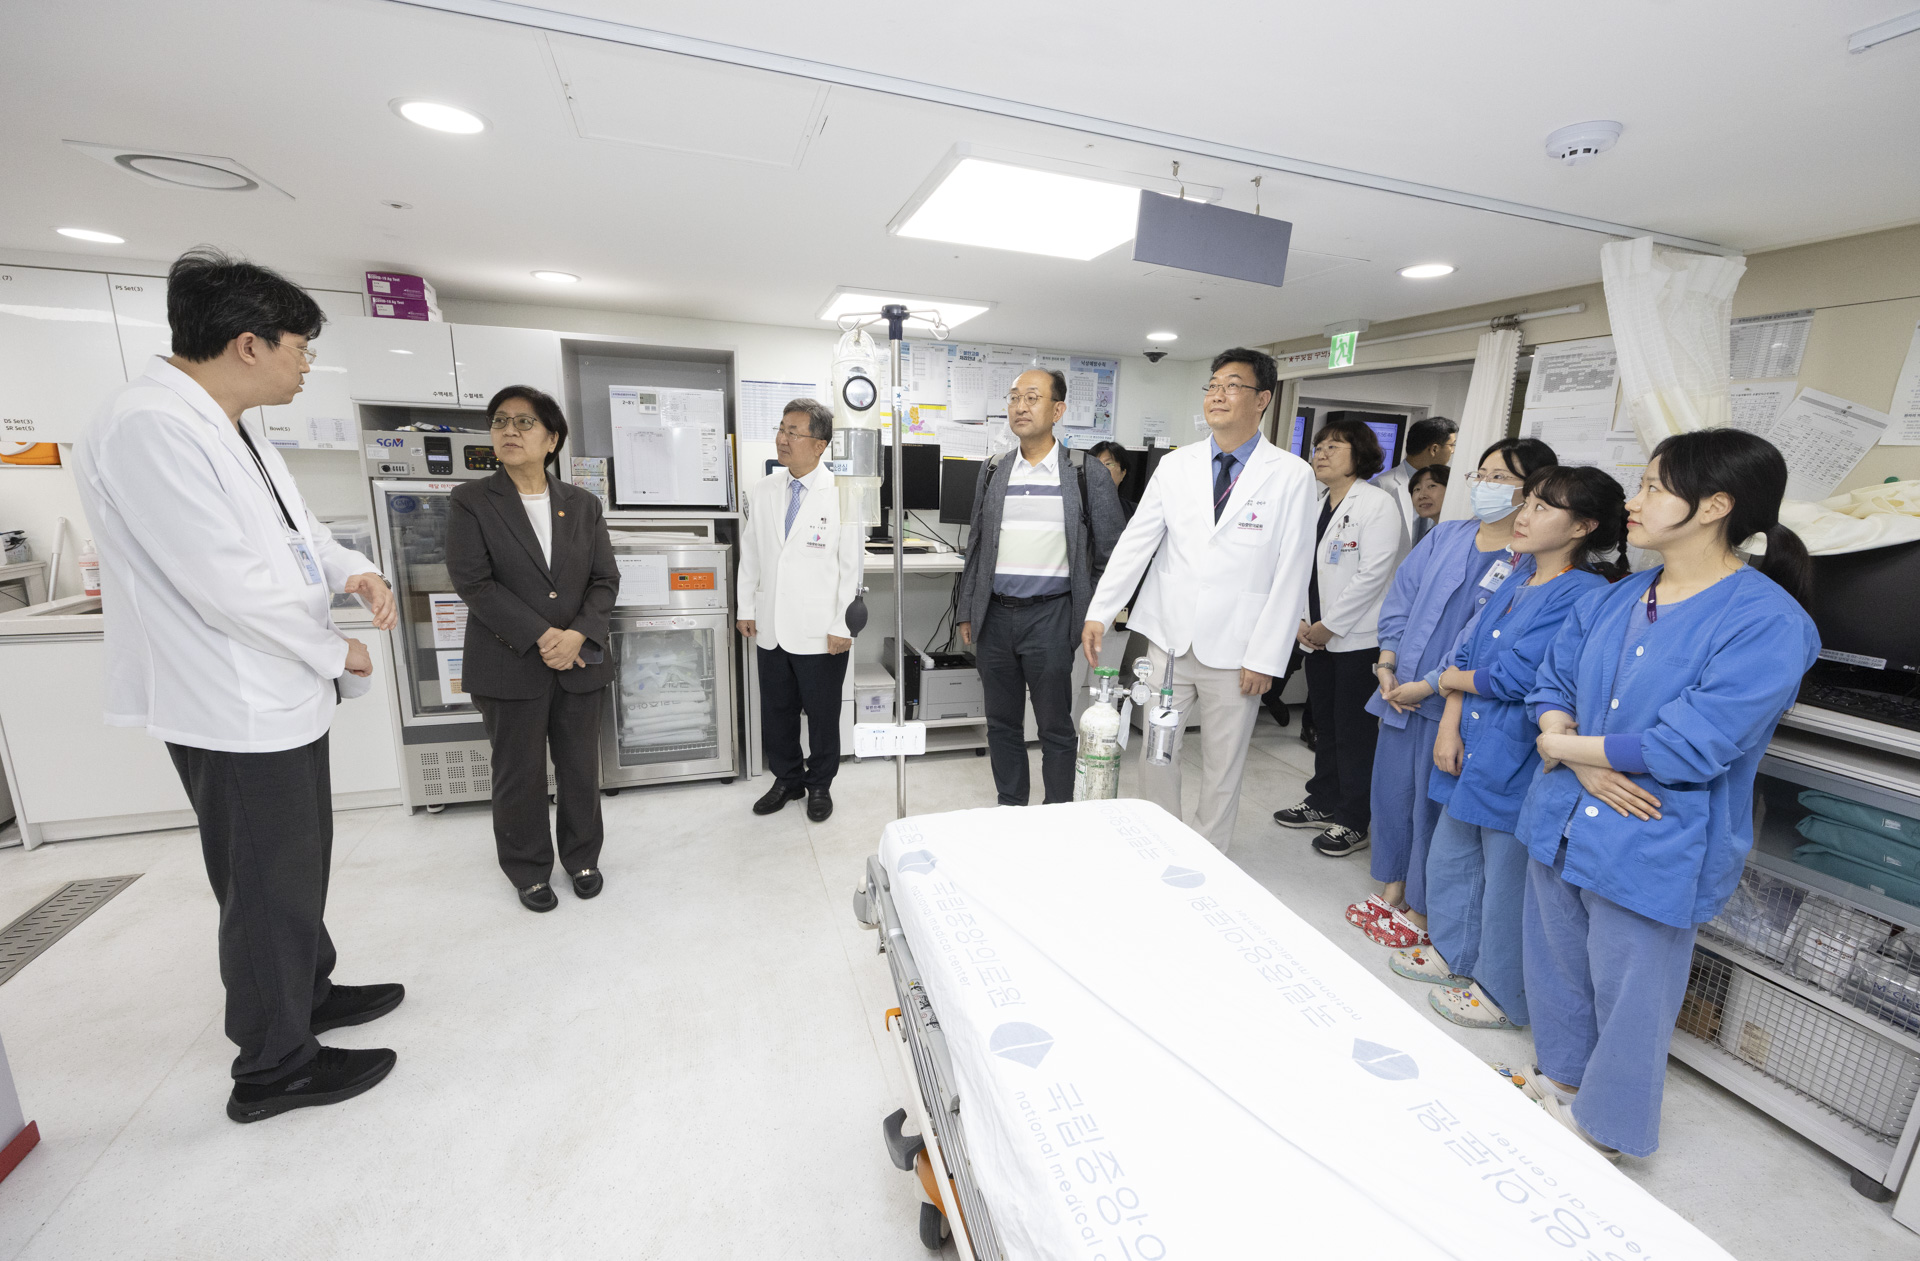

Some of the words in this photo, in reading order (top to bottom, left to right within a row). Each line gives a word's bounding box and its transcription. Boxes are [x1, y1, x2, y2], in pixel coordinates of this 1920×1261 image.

[1080, 360, 1107, 368] 낙상예방수칙
[376, 438, 404, 447] SGM
[1303, 809, 1320, 821] N
[1344, 832, 1359, 847] N
[910, 885, 935, 920] national
[929, 917, 951, 954] medical
[948, 954, 971, 988] center
[932, 881, 1026, 1009] 국립중앙의료원
[1186, 895, 1337, 1028] 국립중앙의료원
[1306, 974, 1363, 1022] national
[1014, 1090, 1061, 1160] national
[1049, 1163, 1104, 1248] medical
[1487, 1130, 1558, 1188] center
